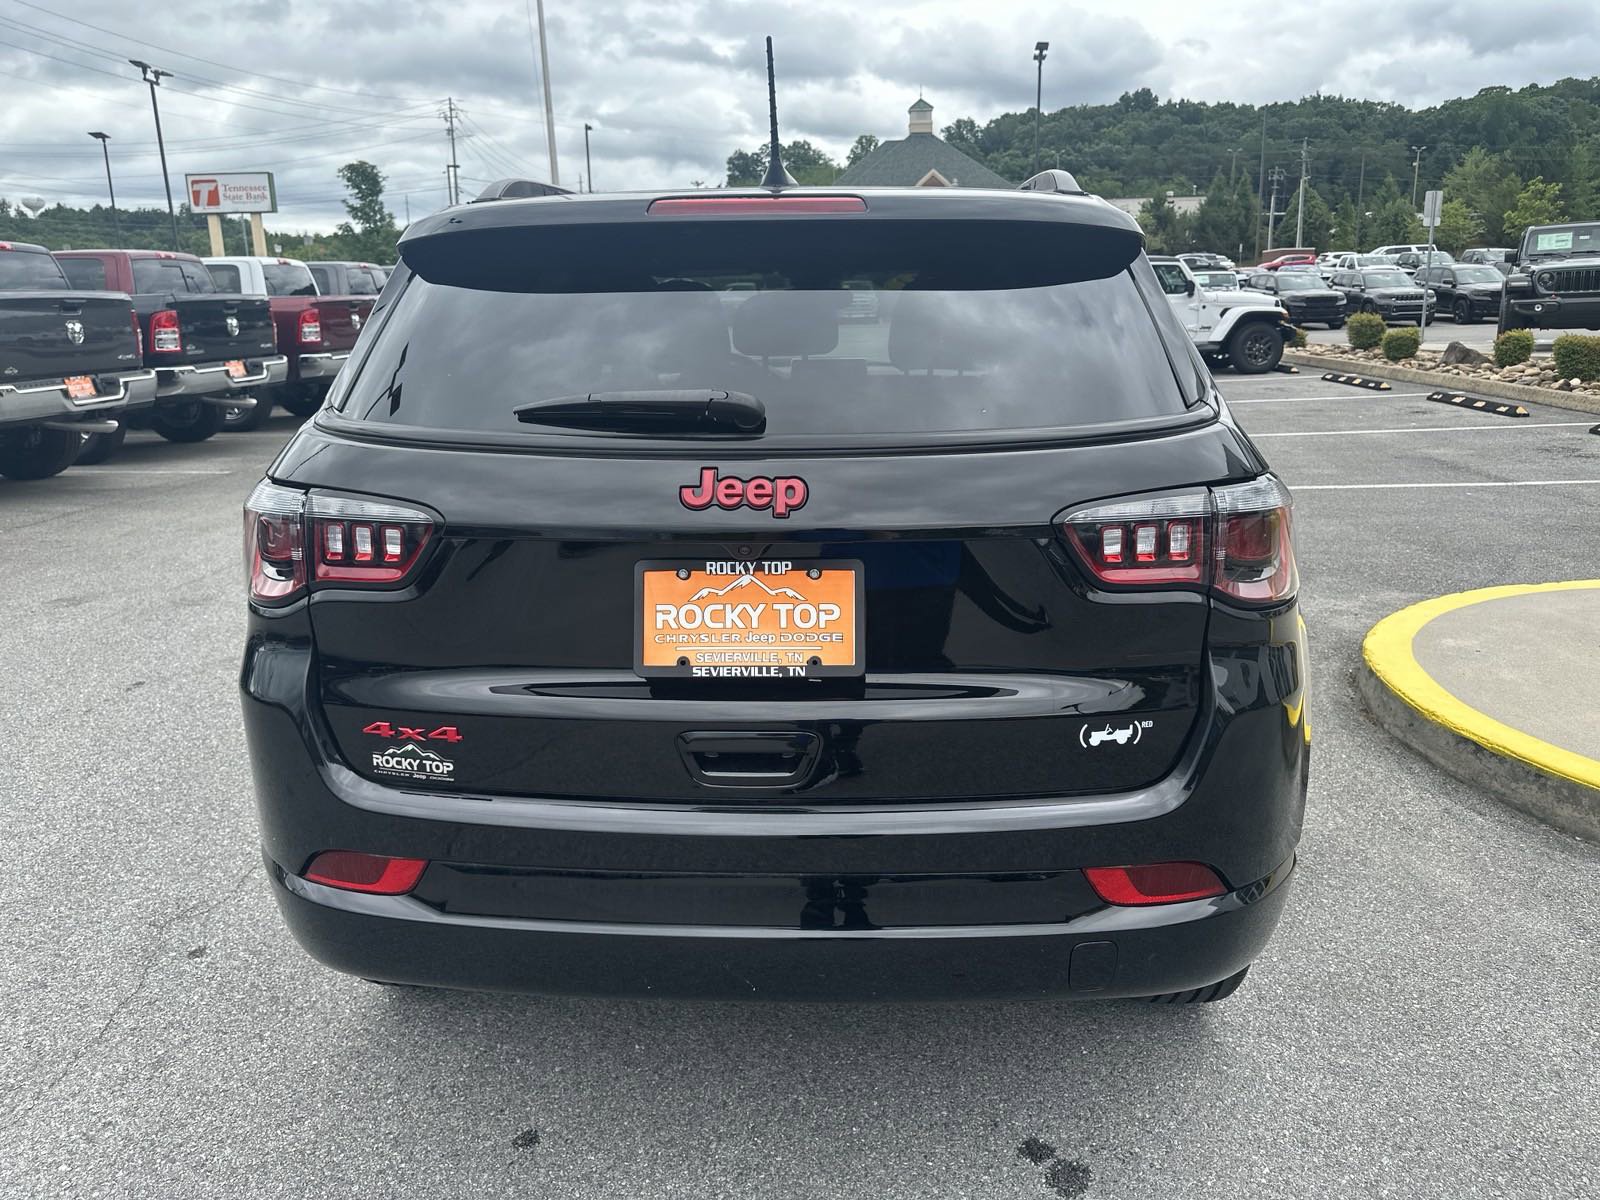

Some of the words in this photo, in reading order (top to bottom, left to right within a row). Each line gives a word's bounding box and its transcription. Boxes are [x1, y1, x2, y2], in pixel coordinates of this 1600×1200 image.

[222, 184, 268, 192] Tennessee
[246, 192, 268, 200] Bank
[680, 467, 808, 518] Jeep
[706, 561, 756, 575] ROCKY
[762, 562, 792, 575] TOP
[655, 603, 767, 630] ROCKY
[772, 603, 841, 629] TOP
[655, 634, 742, 643] CHRYSLER
[745, 631, 776, 643] Jeep
[780, 632, 844, 643] DODGE
[695, 652, 782, 664] SEVIERVILLE,
[786, 652, 804, 663] TN
[692, 667, 783, 677] SEVIERVILLE,
[787, 667, 806, 677] TN
[362, 721, 464, 743] 4x4
[372, 754, 420, 771] ROCKY
[422, 760, 454, 774] TOP
